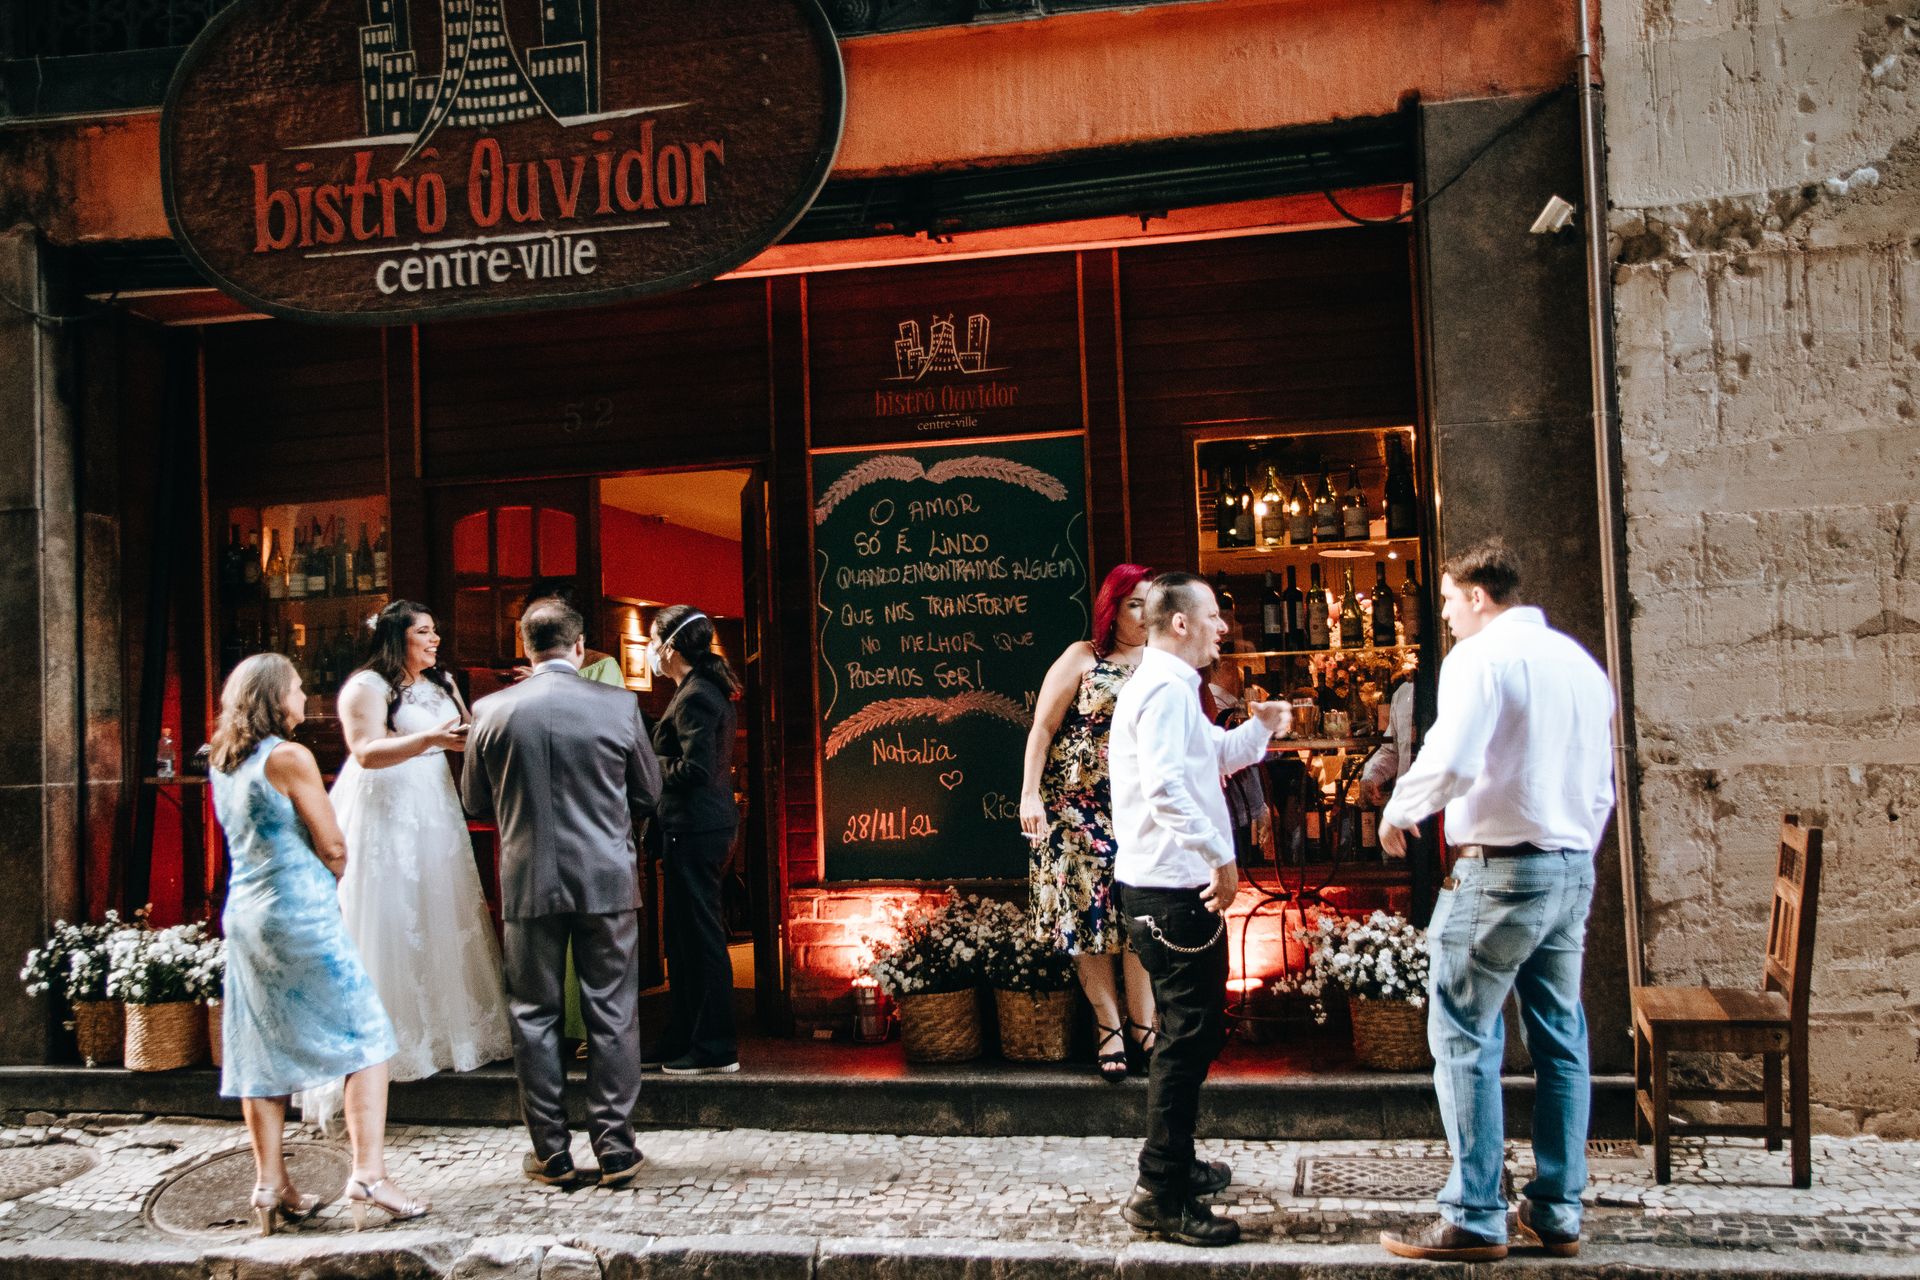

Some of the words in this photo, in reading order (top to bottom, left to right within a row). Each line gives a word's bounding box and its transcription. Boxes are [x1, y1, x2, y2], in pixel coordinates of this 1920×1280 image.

[251, 151, 447, 253] bistrô
[469, 120, 725, 228] Ouvidor
[376, 236, 597, 295] centre-ville
[941, 380, 1019, 411] Ouvidor
[917, 416, 978, 431] centre-ville
[870, 499, 895, 526] O
[908, 493, 981, 523] AMOR
[854, 530, 881, 557] SÓ
[896, 527, 912, 554] É
[836, 566, 901, 591] QUANDO
[1012, 543, 1076, 581] ALGUÉM
[841, 603, 875, 626] QUE
[884, 602, 915, 624] NOS
[920, 592, 1029, 618] TRANSFORME
[860, 634, 881, 655] NO
[900, 631, 984, 653] MELHOR
[845, 661, 924, 689] PODEMOS
[872, 732, 957, 766] Natalia
[842, 806, 938, 844] 28/11/21
